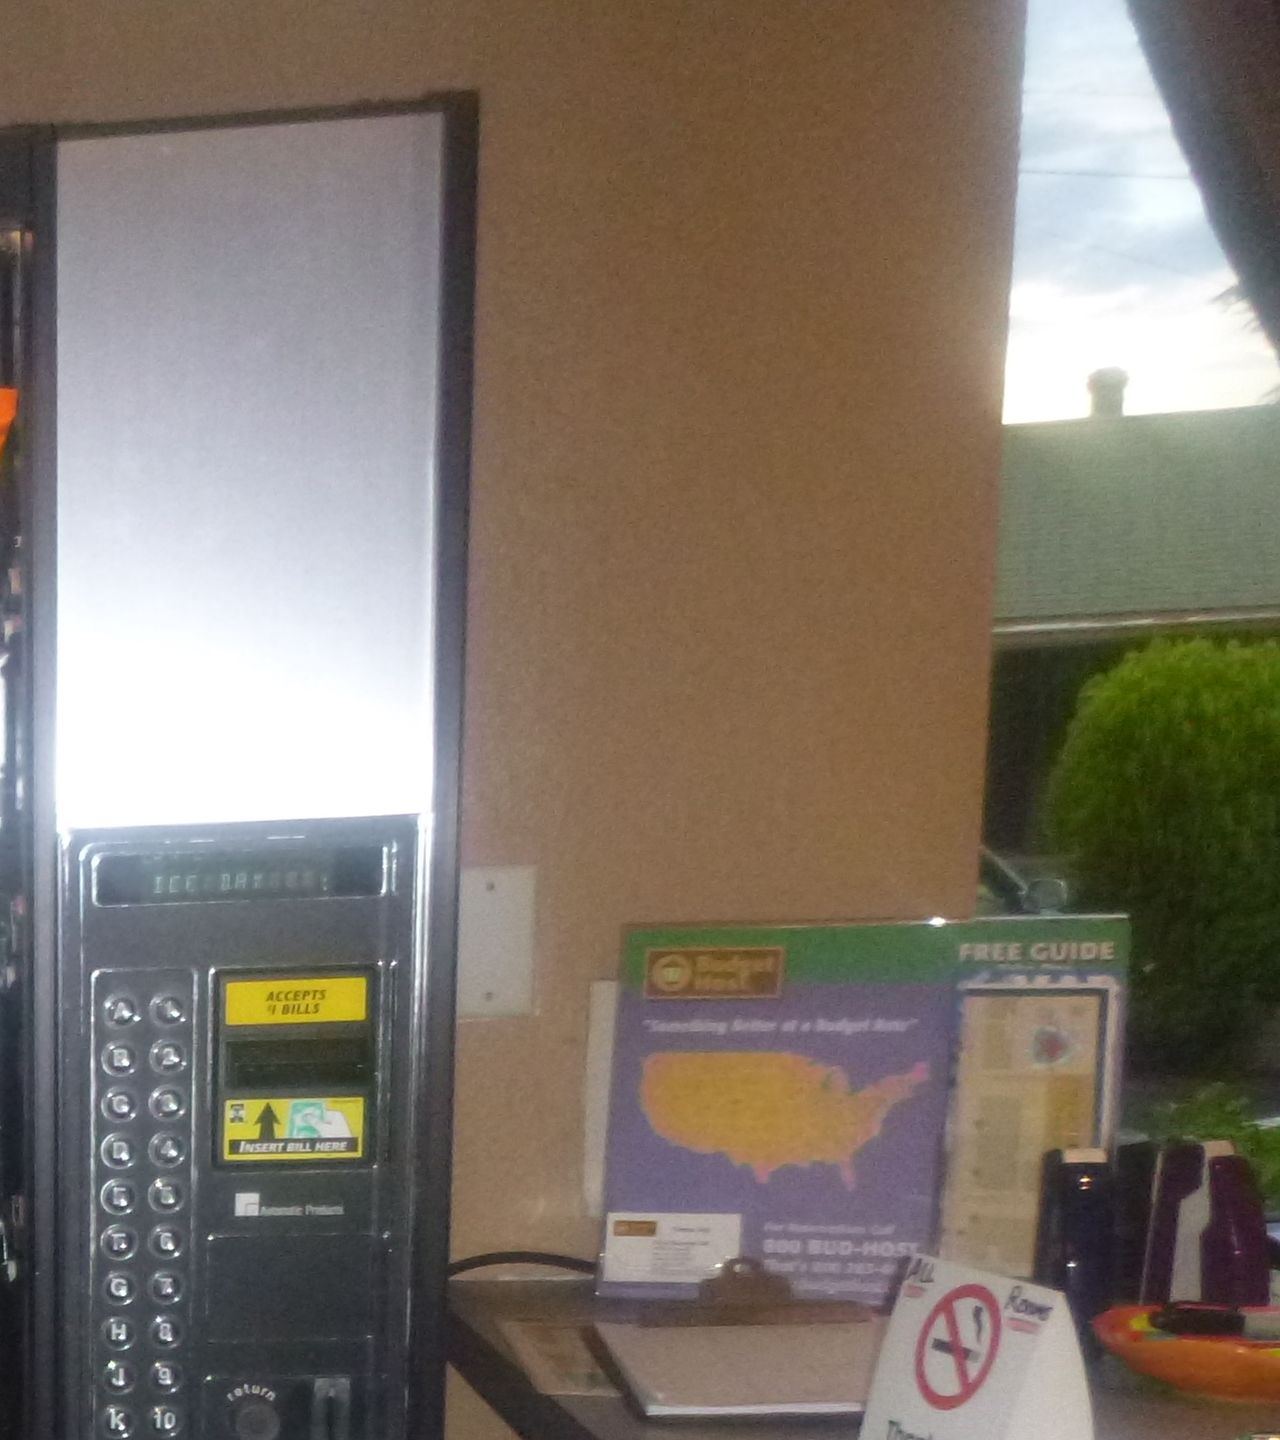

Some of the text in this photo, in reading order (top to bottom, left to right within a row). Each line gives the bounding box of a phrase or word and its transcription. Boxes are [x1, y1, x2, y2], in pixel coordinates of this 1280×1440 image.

[959, 940, 1115, 961] FREE GUIDE
[266, 989, 327, 1003] ACCEPTS
[281, 1003, 320, 1015] BILLS
[239, 1139, 347, 1153] INSERT BILL HERE
[228, 1385, 277, 1402] return
